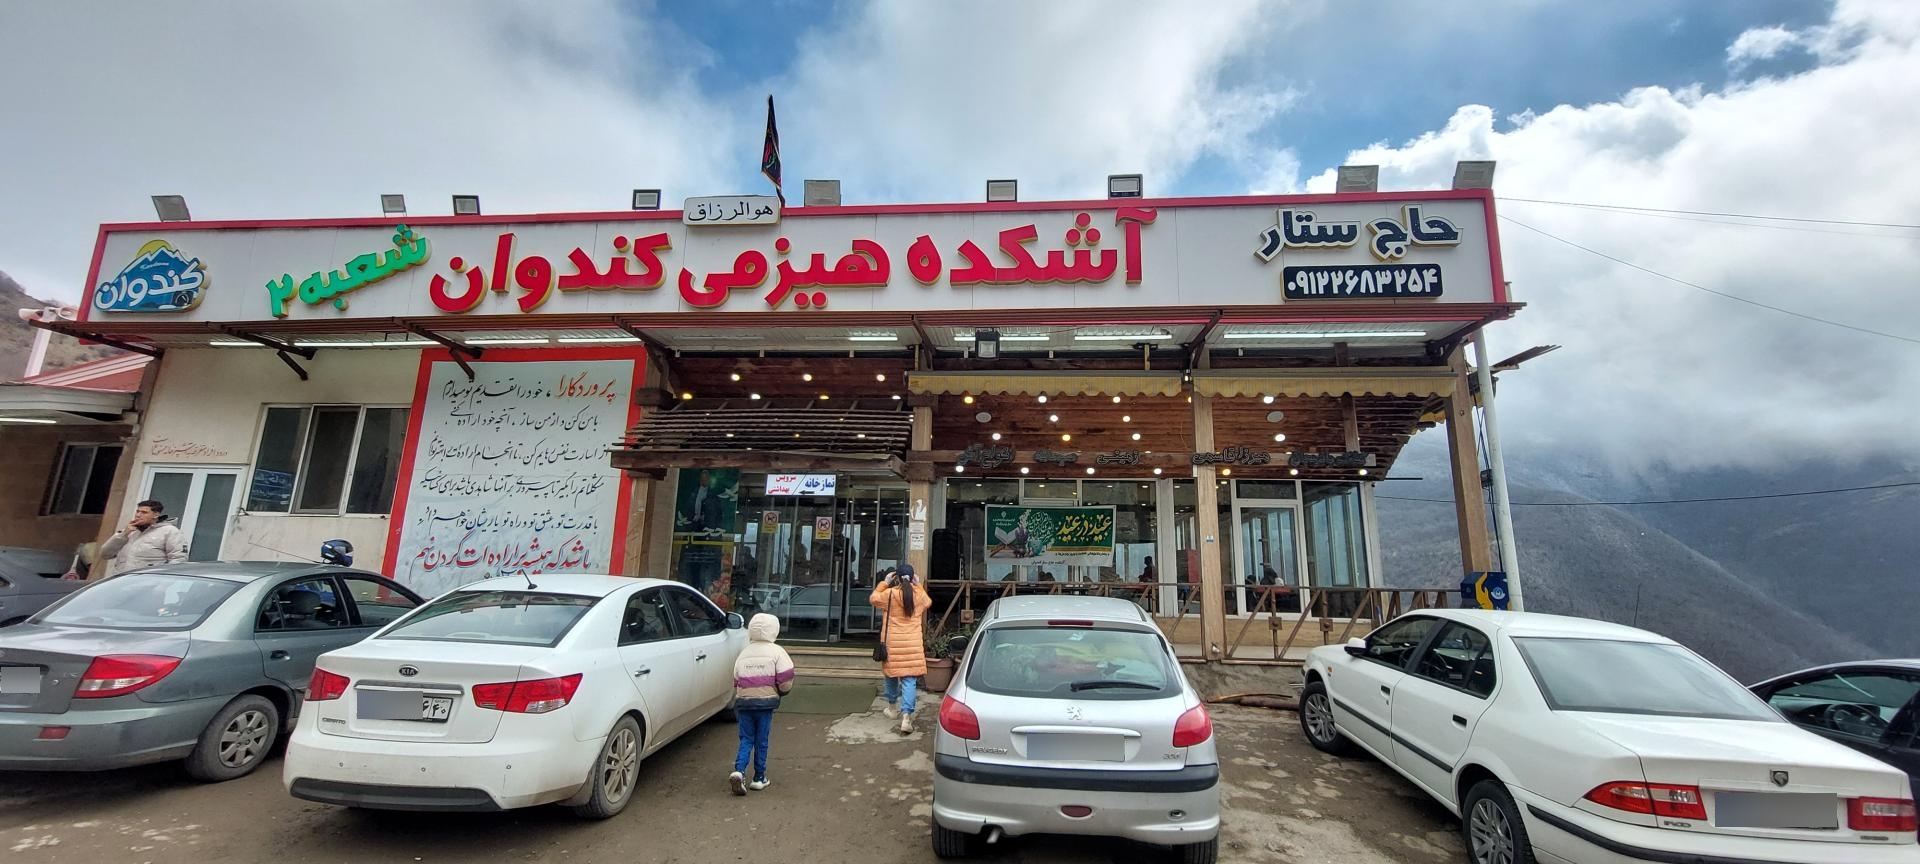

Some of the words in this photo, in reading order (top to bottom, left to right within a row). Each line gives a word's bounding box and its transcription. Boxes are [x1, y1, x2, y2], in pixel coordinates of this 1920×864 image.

[907, 207, 1158, 285] آشکده
[1254, 207, 1361, 264] ستار
[1367, 204, 1464, 262] حاج
[95, 261, 204, 309] کندوان
[300, 224, 432, 311] شعبه
[429, 232, 671, 312] کندوان
[678, 237, 890, 309] هیزمی
[1287, 267, 1438, 296] ۰۹۱۲۲۶۸۳۲۵۴
[266, 273, 294, 318] ۲
[469, 378, 518, 409] تقدیم
[768, 486, 790, 494] بهداشتی
[776, 475, 797, 483] سرویس
[804, 477, 835, 491] نمازخانه
[1056, 515, 1082, 543] عید
[1087, 514, 1112, 543] عید
